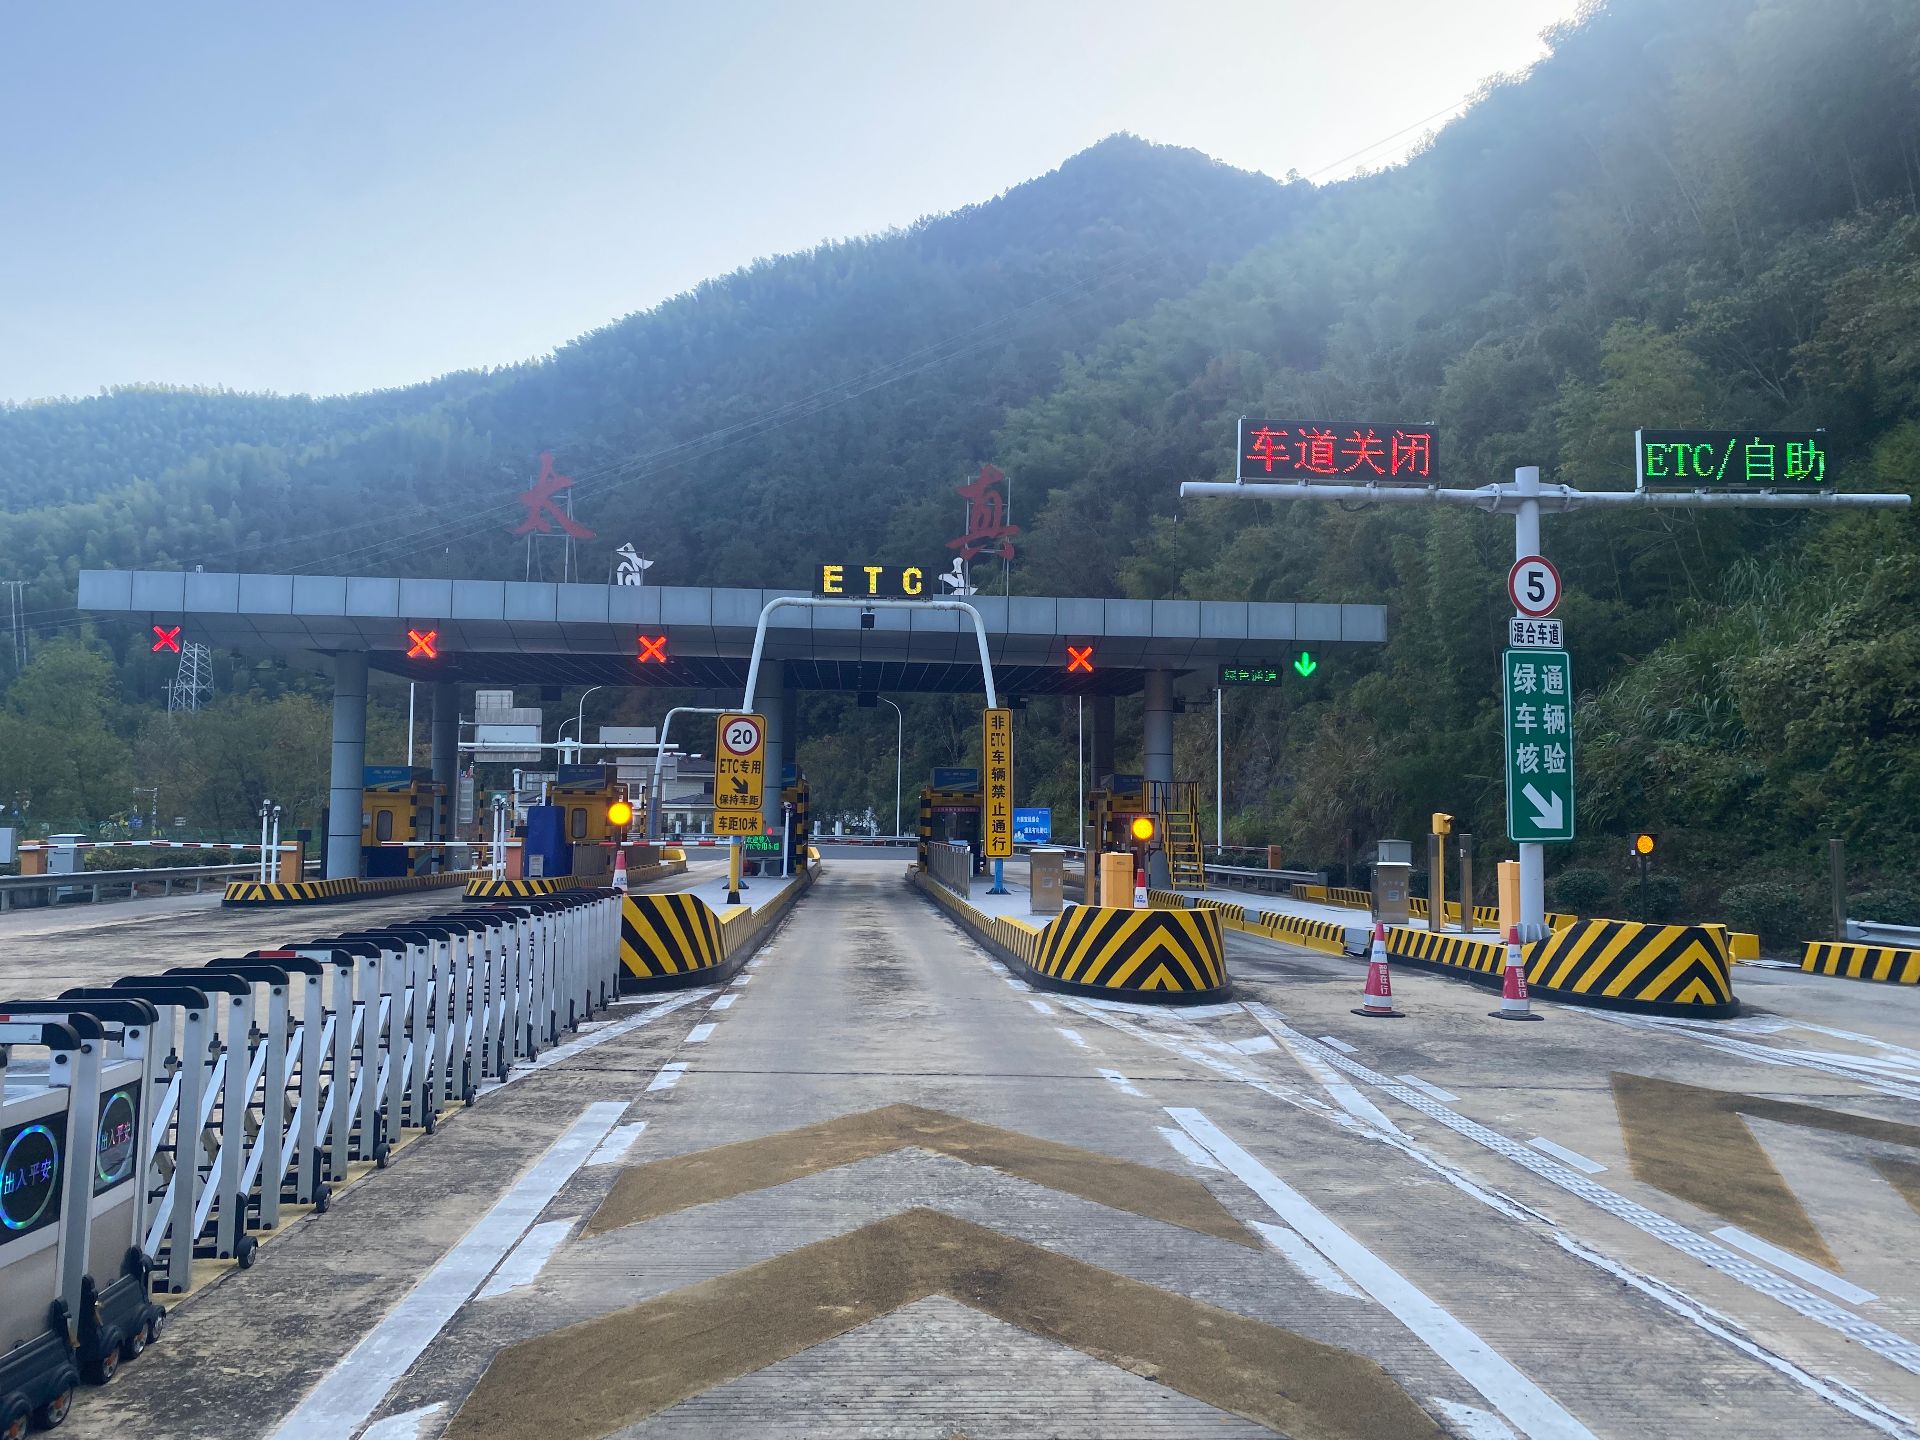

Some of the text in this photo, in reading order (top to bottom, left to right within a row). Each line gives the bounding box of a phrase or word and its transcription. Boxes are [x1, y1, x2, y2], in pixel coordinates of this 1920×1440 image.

[1247, 426, 1431, 477] 车道关闭
[1646, 437, 1825, 482] ETC/自助
[823, 566, 923, 596] ETC
[1526, 572, 1546, 603] 5
[1513, 622, 1560, 646] 混合车道
[1513, 663, 1565, 695] 绿通
[1514, 703, 1566, 735] 车辆
[731, 729, 753, 745] 20
[719, 759, 761, 774] ETC专用
[1516, 743, 1567, 774] 核验
[719, 794, 759, 806] 保持车距
[718, 816, 758, 831] 车距10米
[100, 1122, 131, 1151] 出入平安
[3, 1159, 52, 1195] 出入平安
